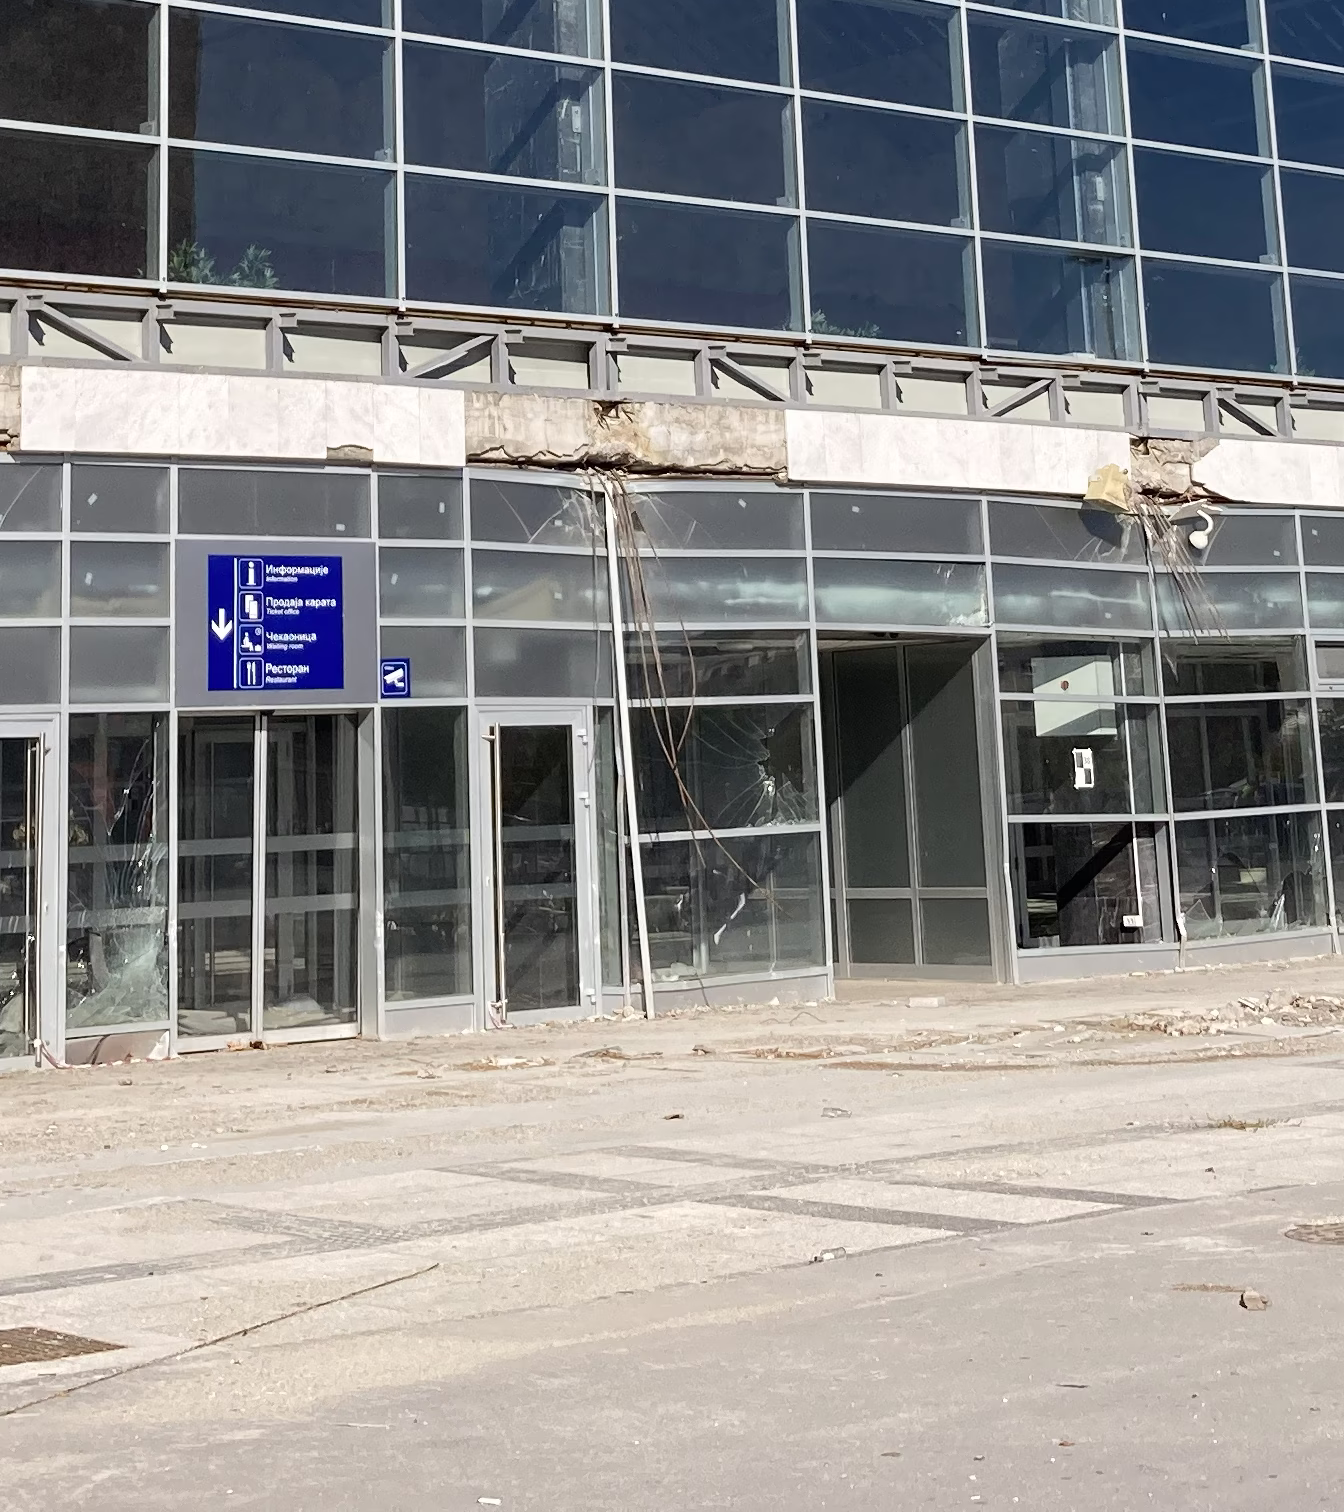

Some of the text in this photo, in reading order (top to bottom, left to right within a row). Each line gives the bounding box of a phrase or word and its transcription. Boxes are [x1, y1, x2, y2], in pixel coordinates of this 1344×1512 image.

[265, 564, 329, 576] Информације
[266, 597, 336, 608] Продаја карата
[265, 663, 310, 675] Ресторан
